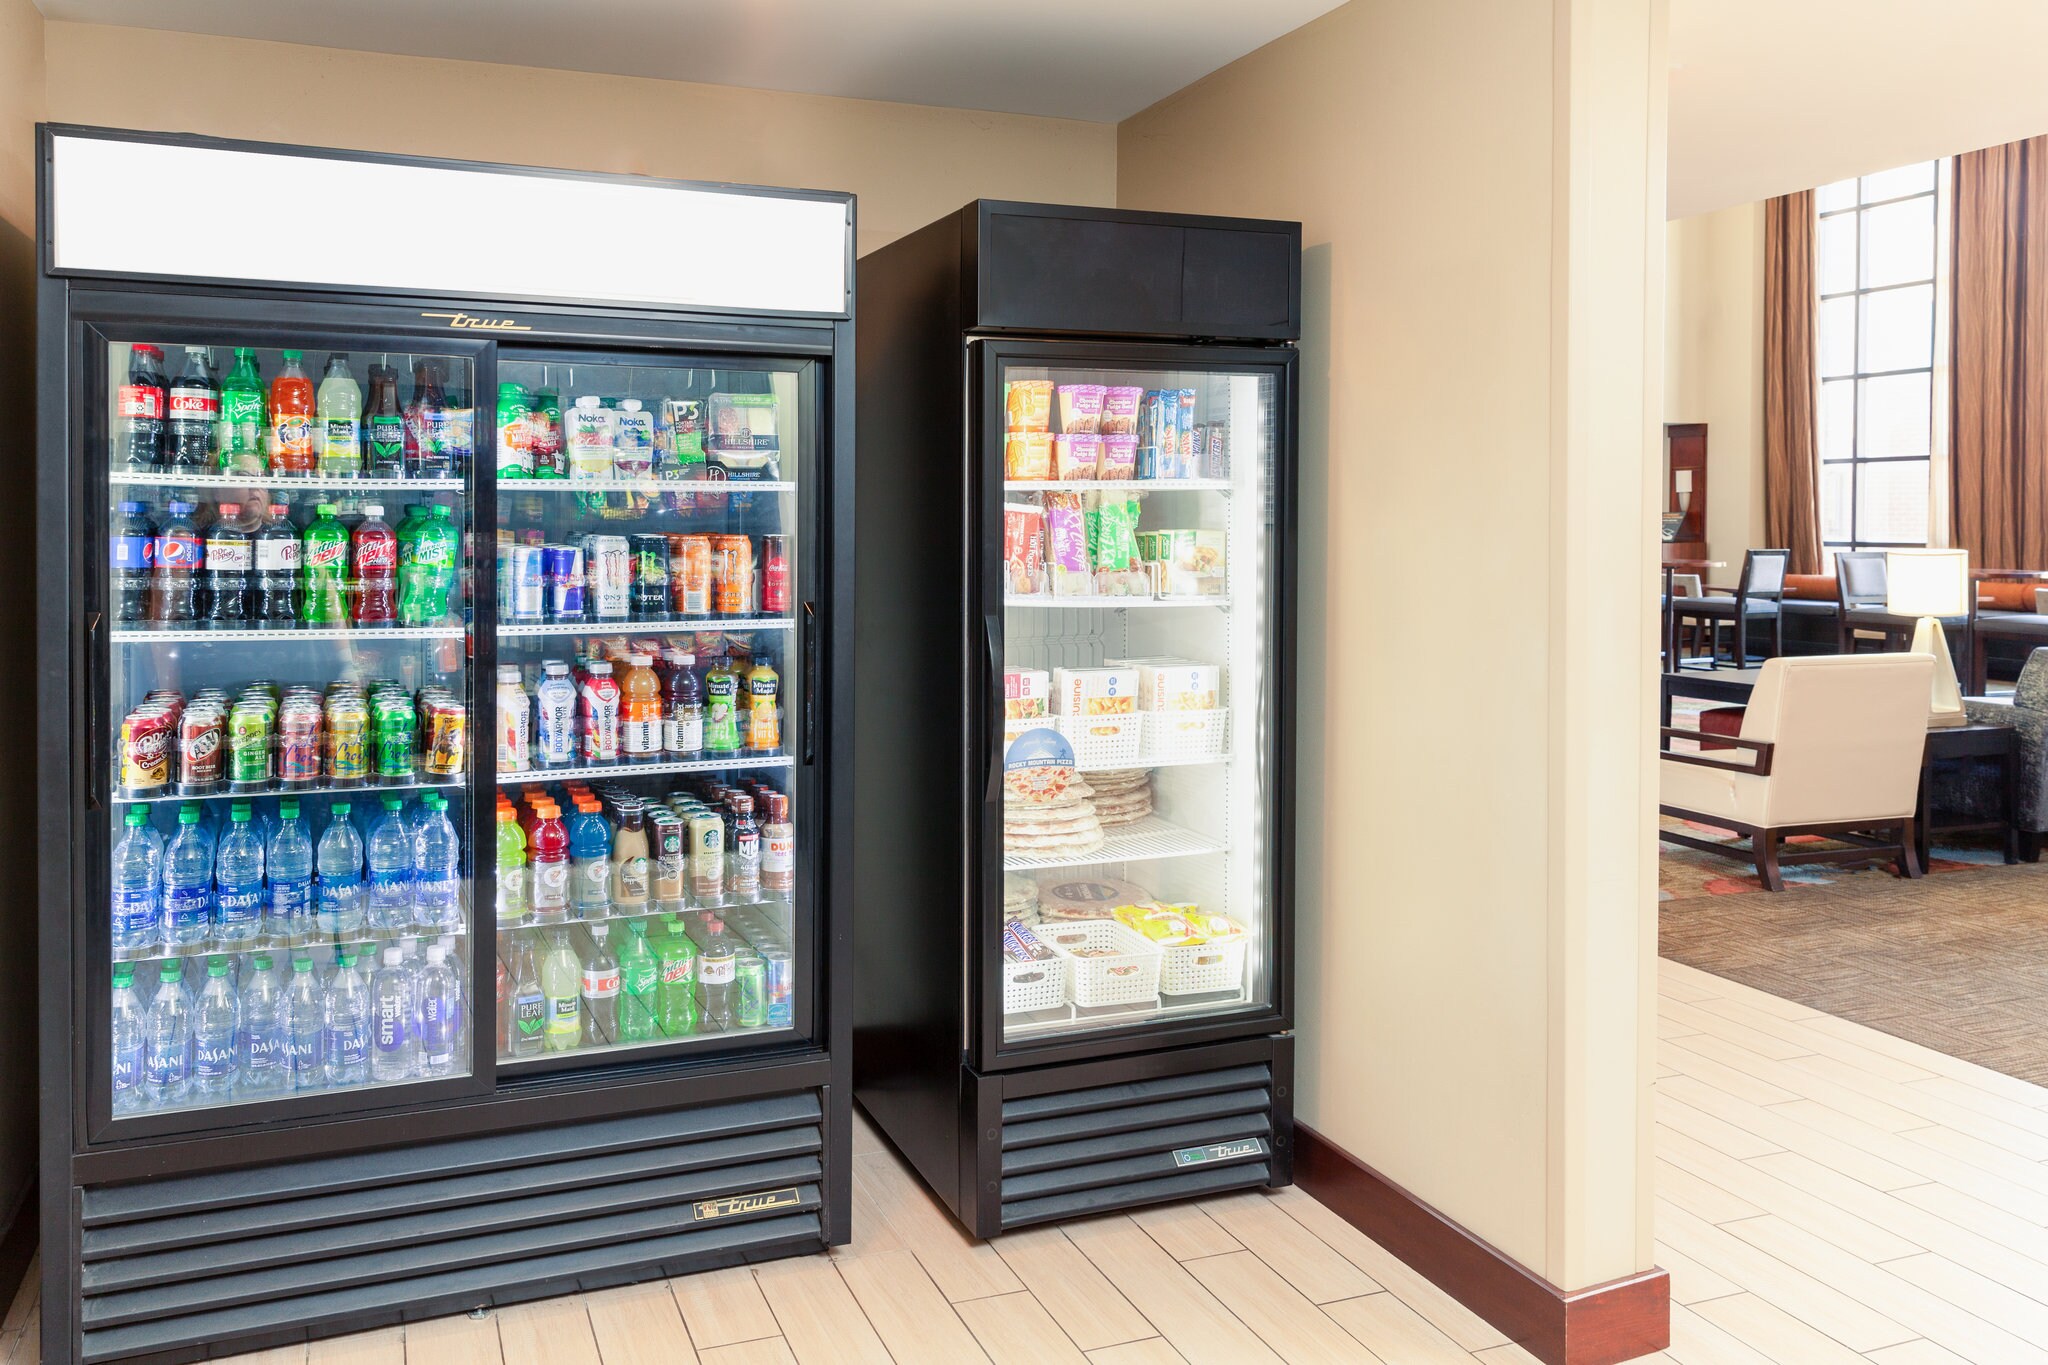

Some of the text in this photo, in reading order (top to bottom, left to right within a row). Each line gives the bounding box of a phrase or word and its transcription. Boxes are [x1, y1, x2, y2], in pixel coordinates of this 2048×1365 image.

[421, 313, 532, 330] true
[173, 397, 204, 410] Coke
[236, 402, 262, 414] Sprite
[578, 413, 606, 422] Noka
[674, 402, 699, 421] P3
[620, 417, 646, 426] Noka
[665, 470, 680, 480] P3
[418, 548, 447, 562] MIST
[193, 729, 217, 760] A&W
[141, 758, 161, 768] Cream
[371, 876, 410, 894] DASANI
[426, 998, 437, 1021] water
[521, 1003, 543, 1011] PURE
[380, 996, 394, 1044] smart
[251, 1038, 280, 1054] DASA
[198, 1044, 238, 1063] DASANI
[1209, 1145, 1254, 1157] true
